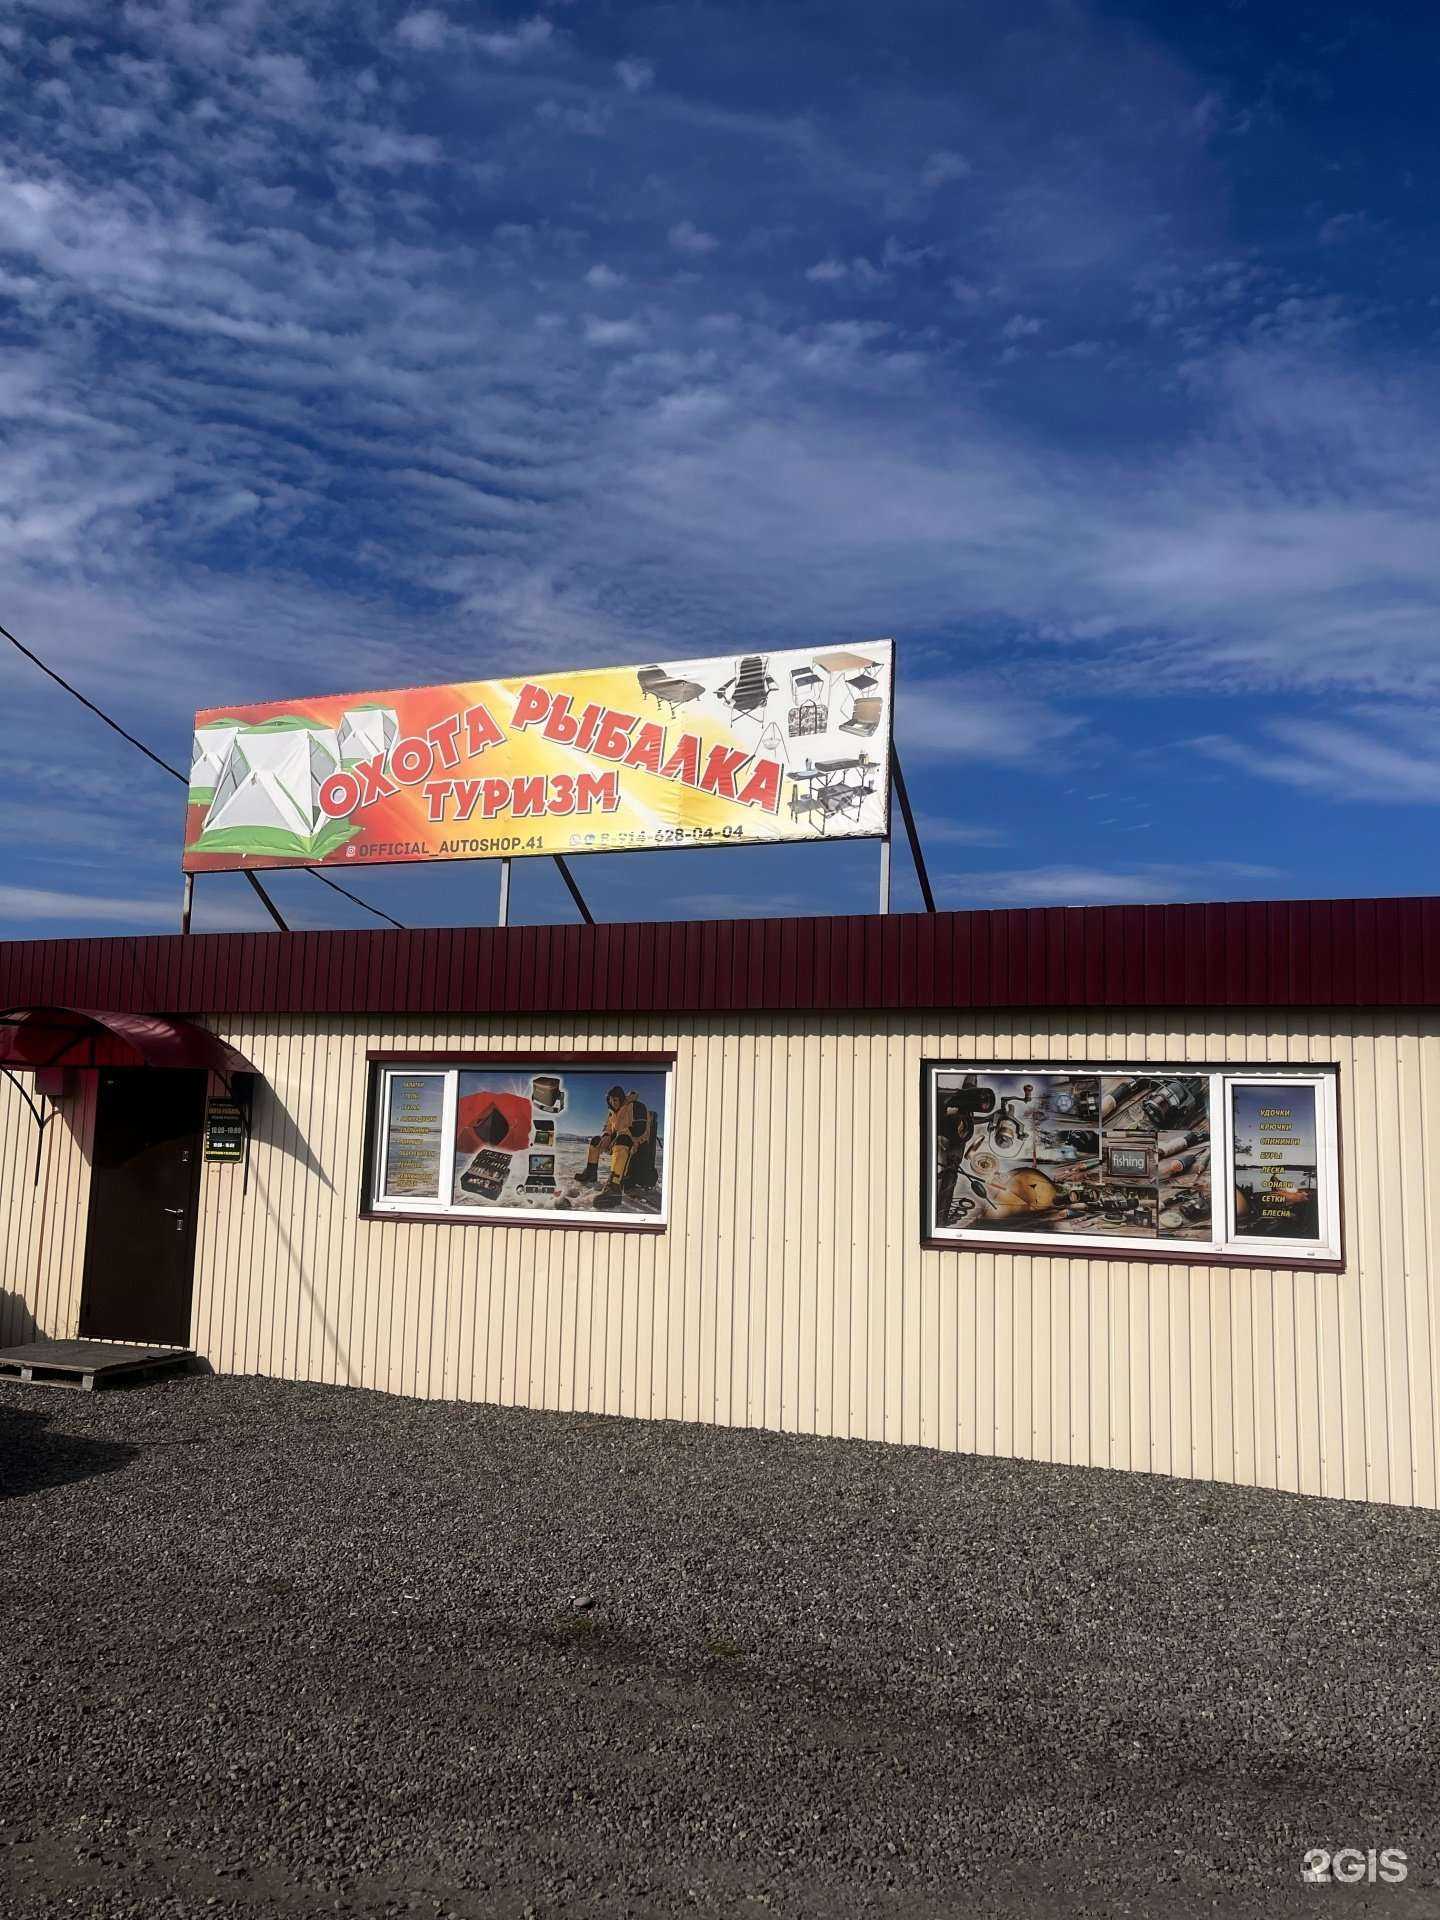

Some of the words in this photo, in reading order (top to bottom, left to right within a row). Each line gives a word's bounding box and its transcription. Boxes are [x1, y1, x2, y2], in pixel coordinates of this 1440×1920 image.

[509, 683, 785, 815] РЫБАЛКА
[318, 703, 507, 820] ОХОТА
[422, 769, 622, 821] ТУРИЗМ
[359, 836, 544, 857] OFFICIAL_AUTOSHOP.41
[1259, 1109, 1290, 1117] УДОЧКИ
[1259, 1123, 1292, 1131] КРЮЧКИ
[1112, 1154, 1145, 1169] fishing
[1261, 1166, 1285, 1174] ЛЕСКА
[1261, 1195, 1286, 1203] СЕТКИ
[1262, 1209, 1291, 1217] БЛЕСНА
